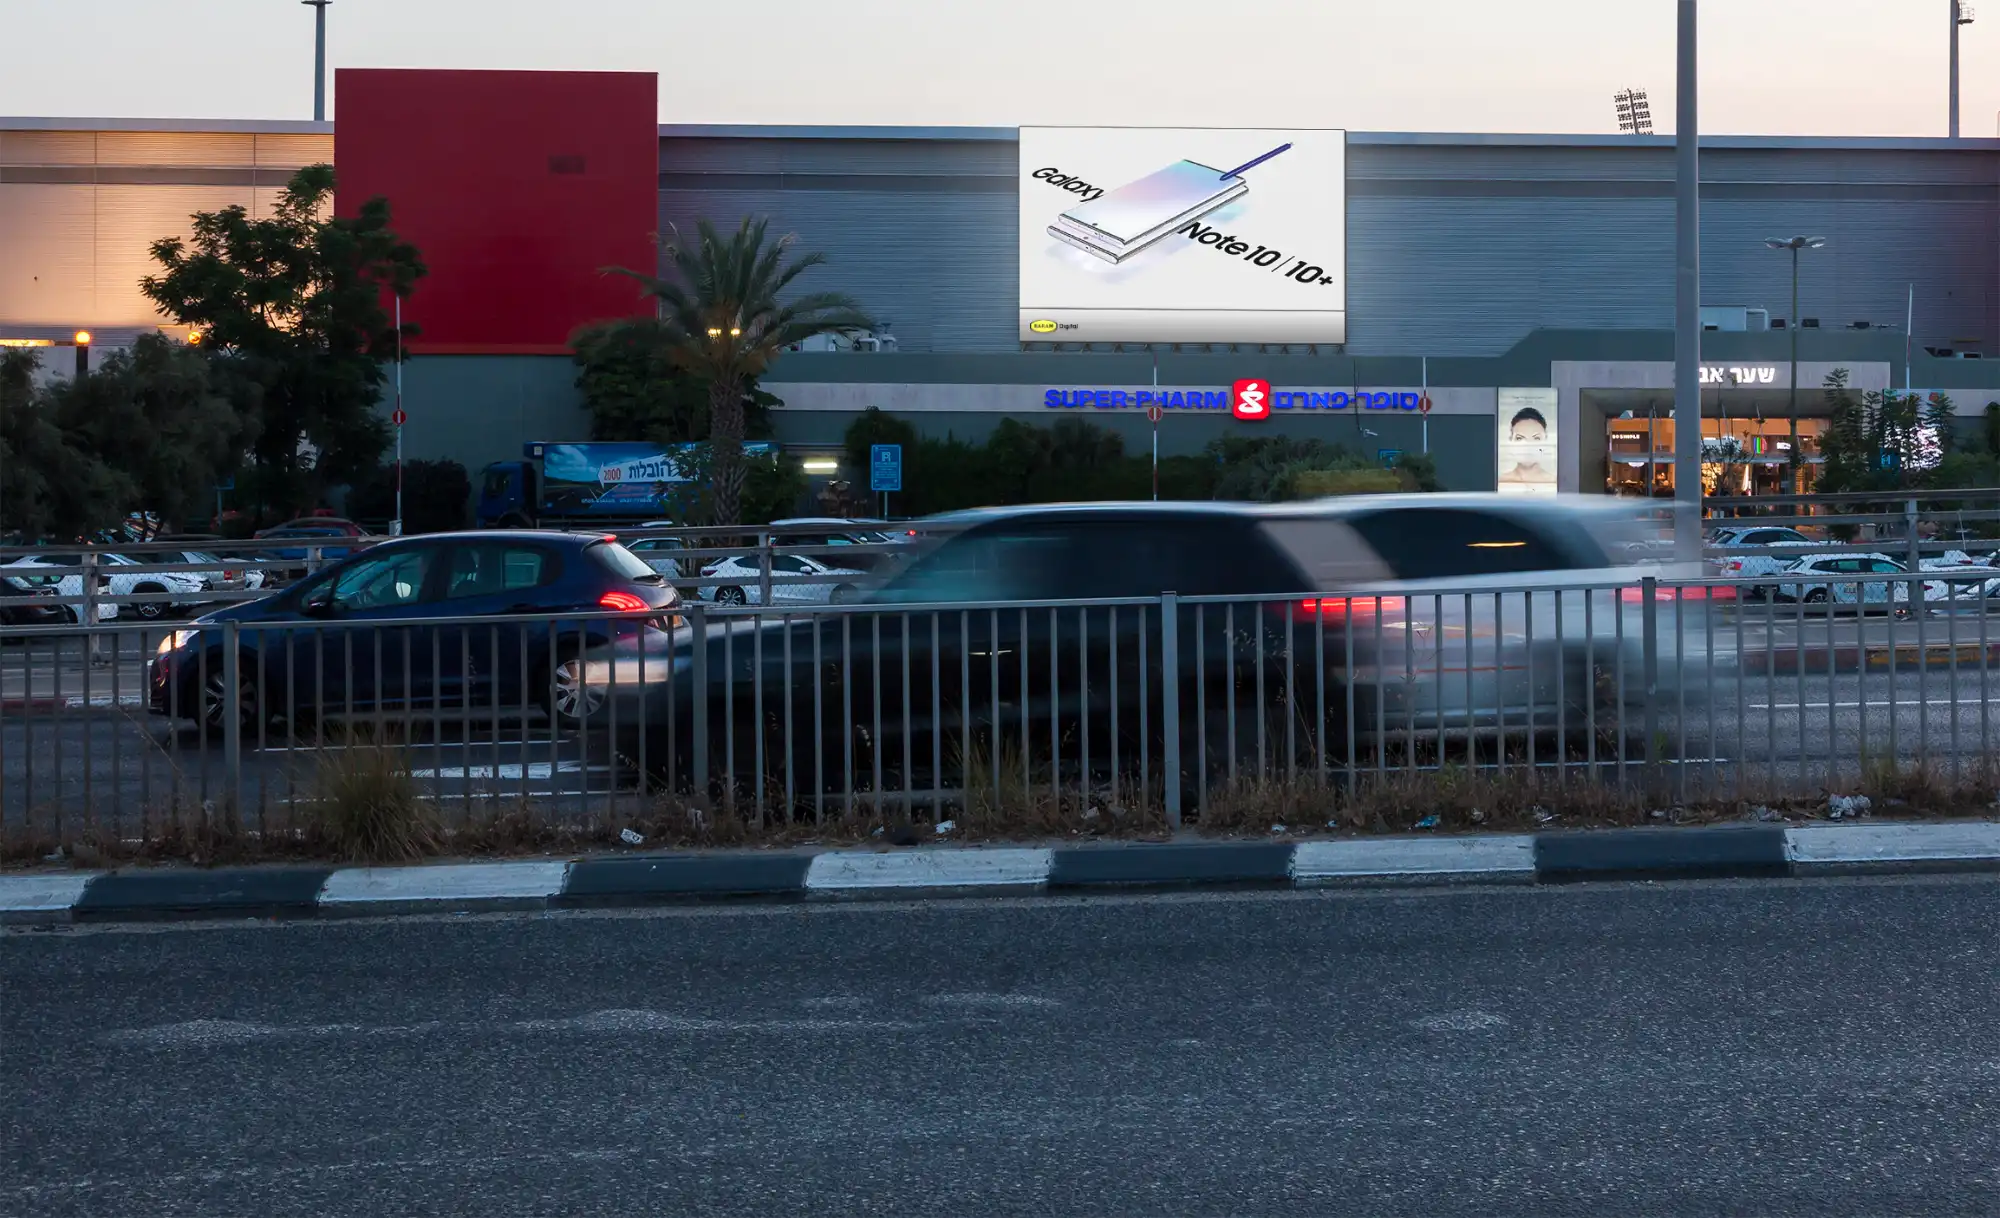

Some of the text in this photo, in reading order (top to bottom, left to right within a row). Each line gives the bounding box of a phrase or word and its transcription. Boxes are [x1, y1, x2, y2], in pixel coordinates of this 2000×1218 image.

[1032, 167, 1104, 203] Galaxy
[1284, 260, 1333, 286] 10+
[1730, 367, 1776, 384] שער
[1044, 389, 1228, 409] SUPER-PHARM
[1274, 391, 1420, 410] סופר-פארם
[603, 460, 672, 481] הובלות 2000
